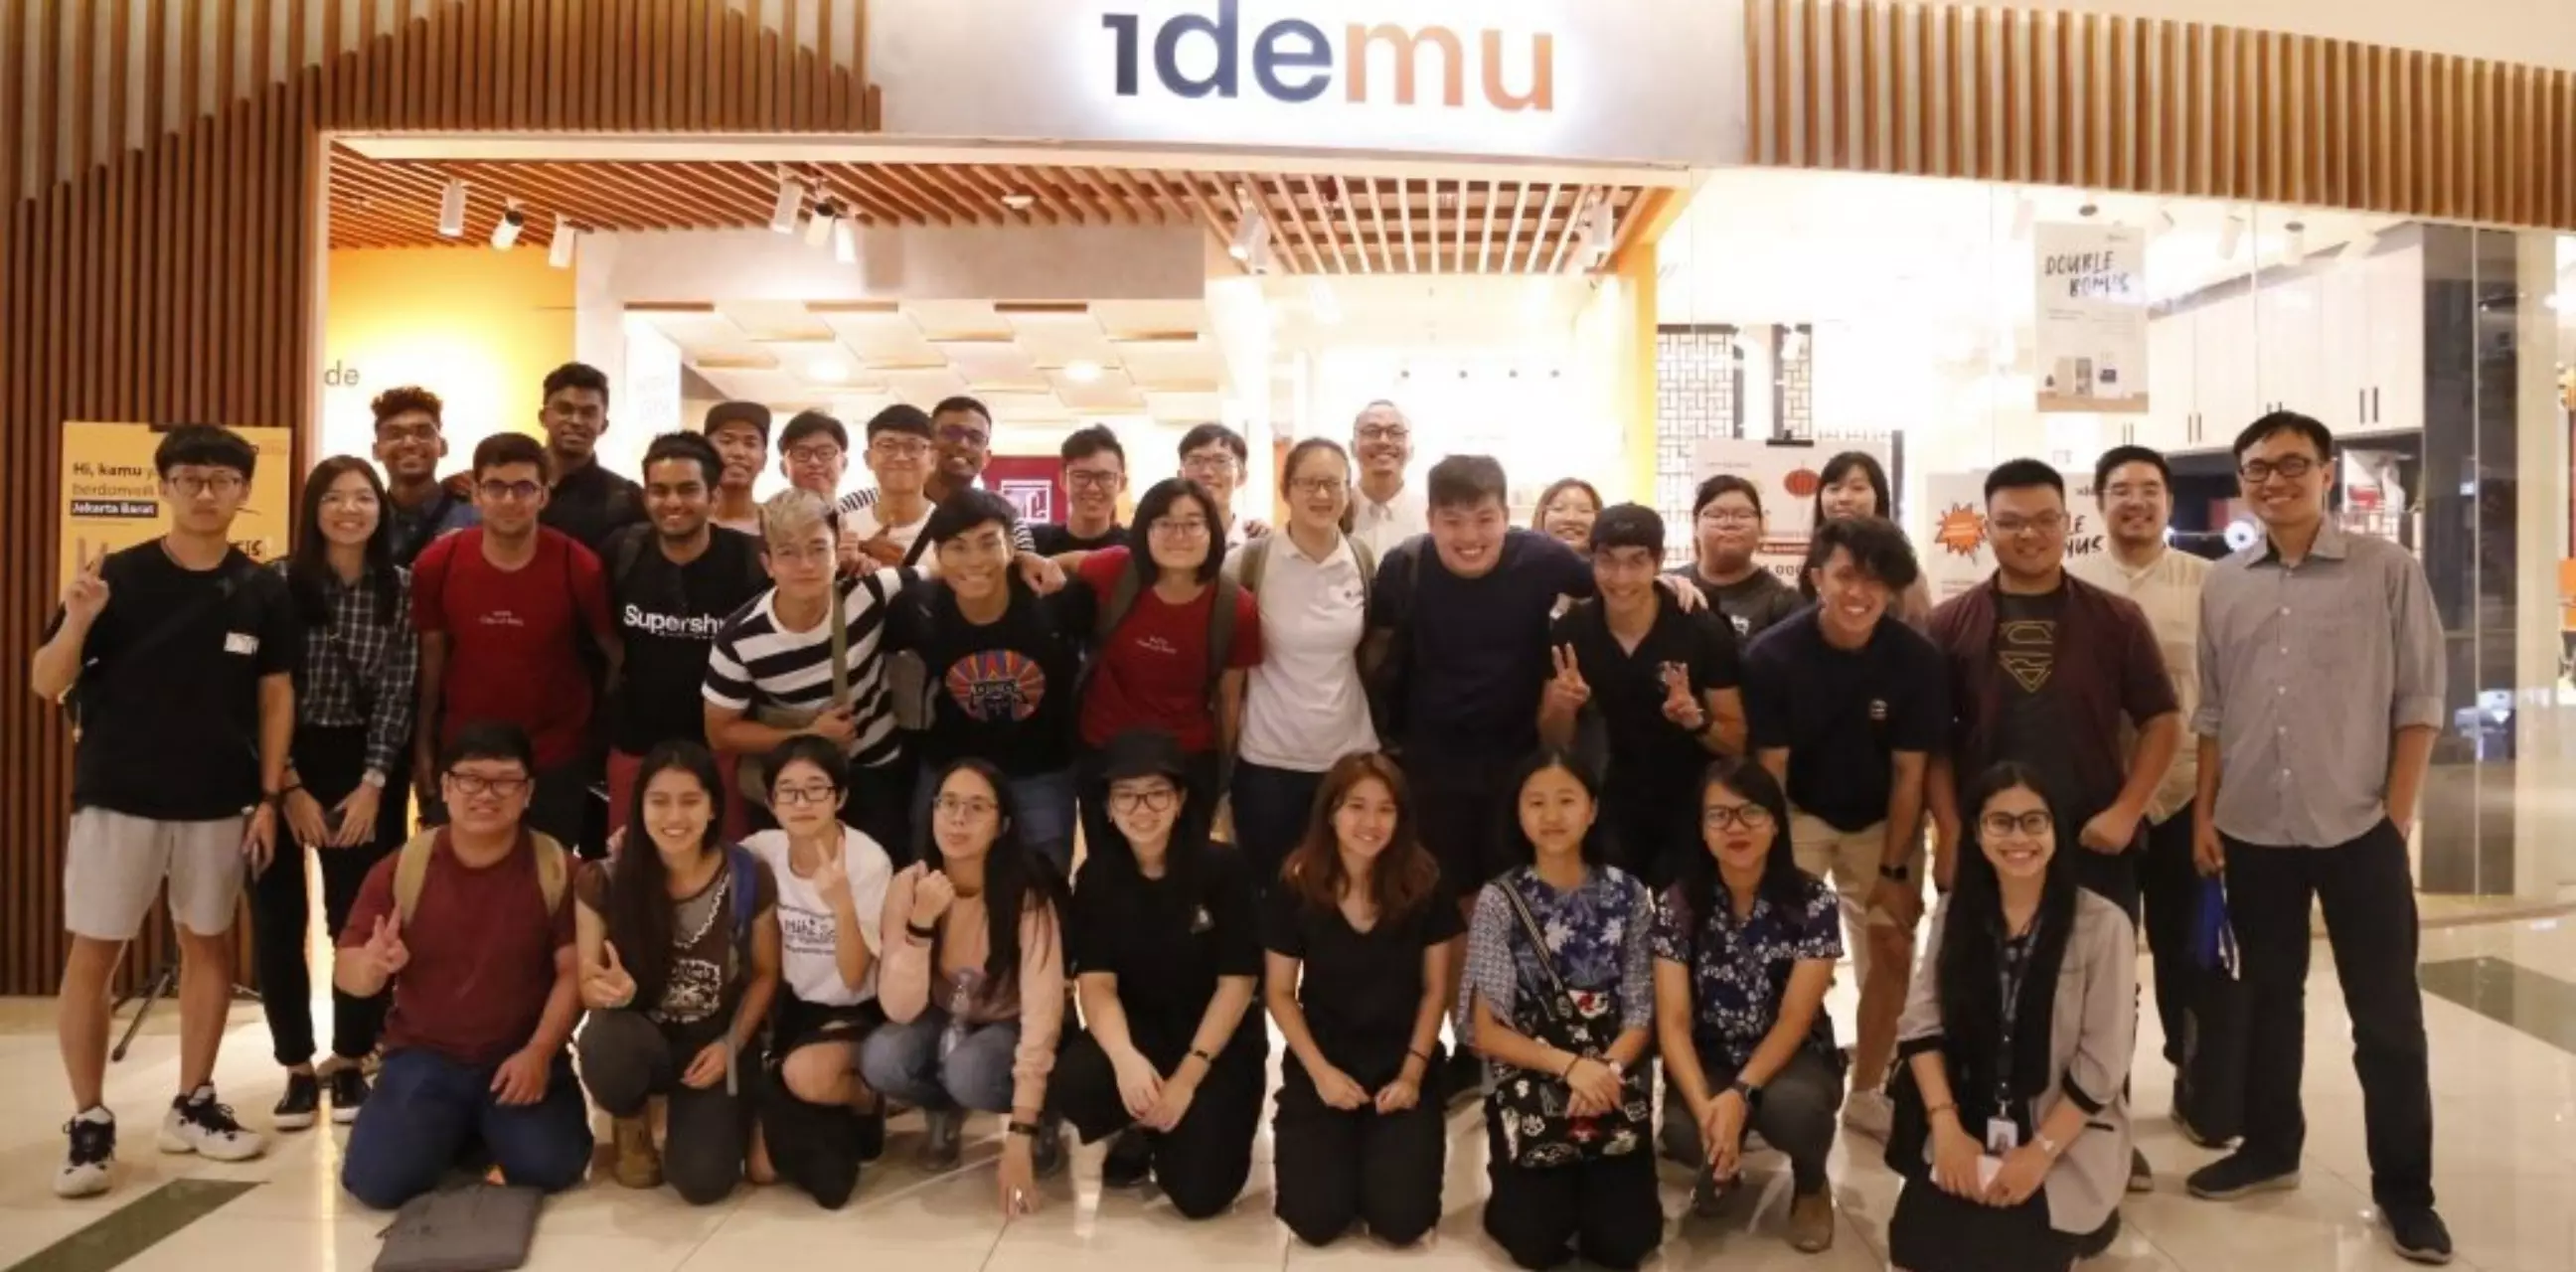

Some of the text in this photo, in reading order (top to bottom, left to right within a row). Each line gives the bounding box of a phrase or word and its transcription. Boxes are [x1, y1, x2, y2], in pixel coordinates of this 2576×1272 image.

[2045, 250, 2114, 276] DOUBLE
[97, 462, 142, 476] kamu
[73, 502, 119, 514] Jakarta
